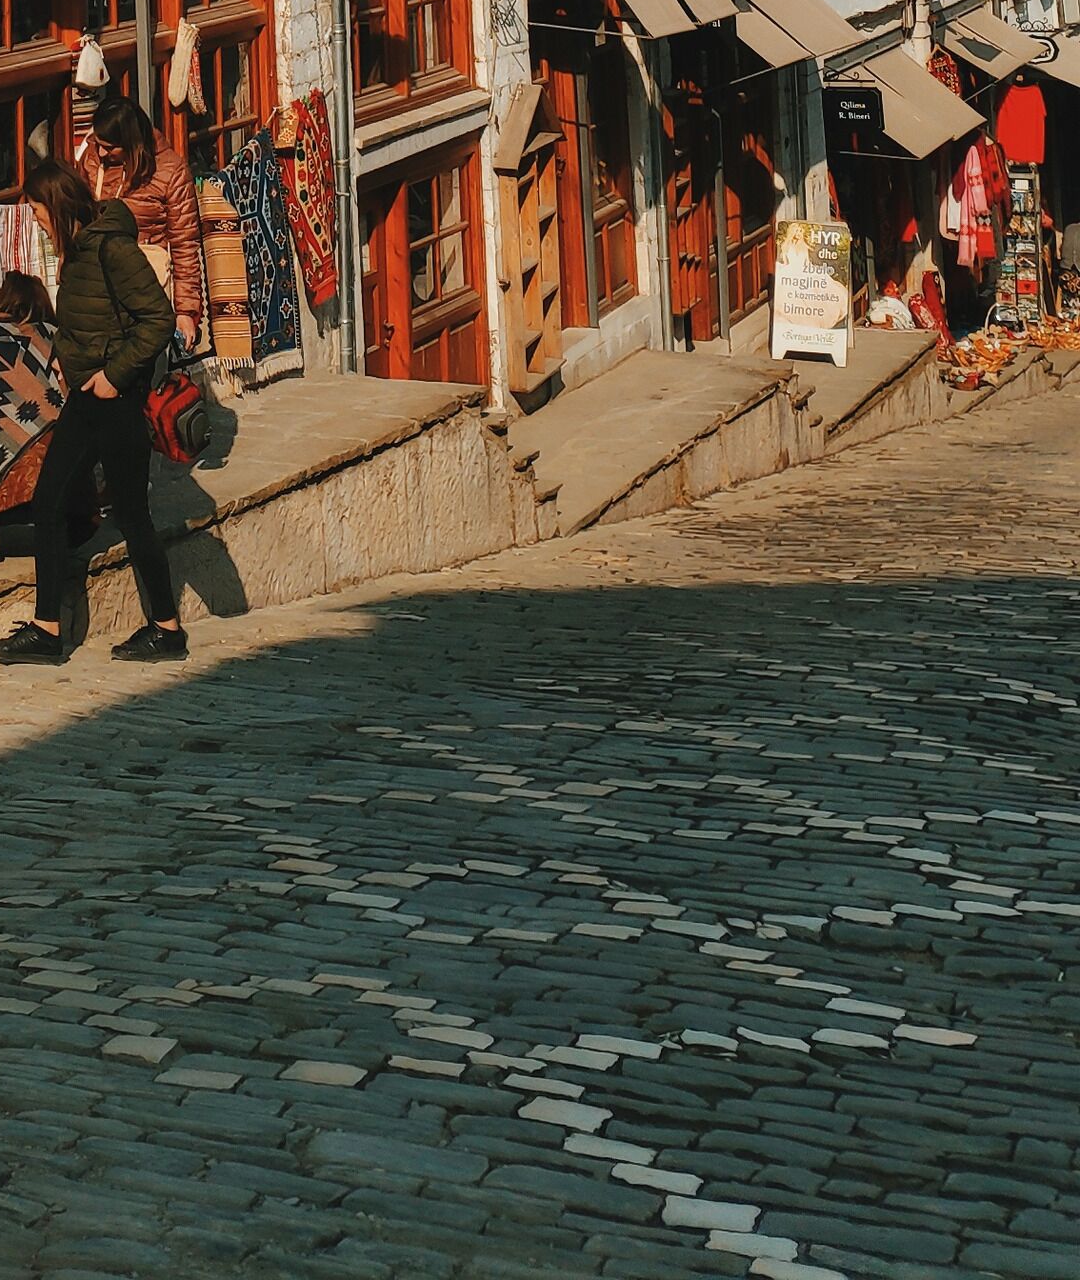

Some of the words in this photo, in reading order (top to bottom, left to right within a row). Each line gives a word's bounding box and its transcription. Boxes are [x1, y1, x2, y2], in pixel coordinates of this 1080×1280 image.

[840, 101, 866, 110] Qilima
[811, 230, 841, 246] HYR
[818, 248, 838, 260] dhe
[781, 276, 828, 290] magjinë
[783, 303, 825, 317] bimore
